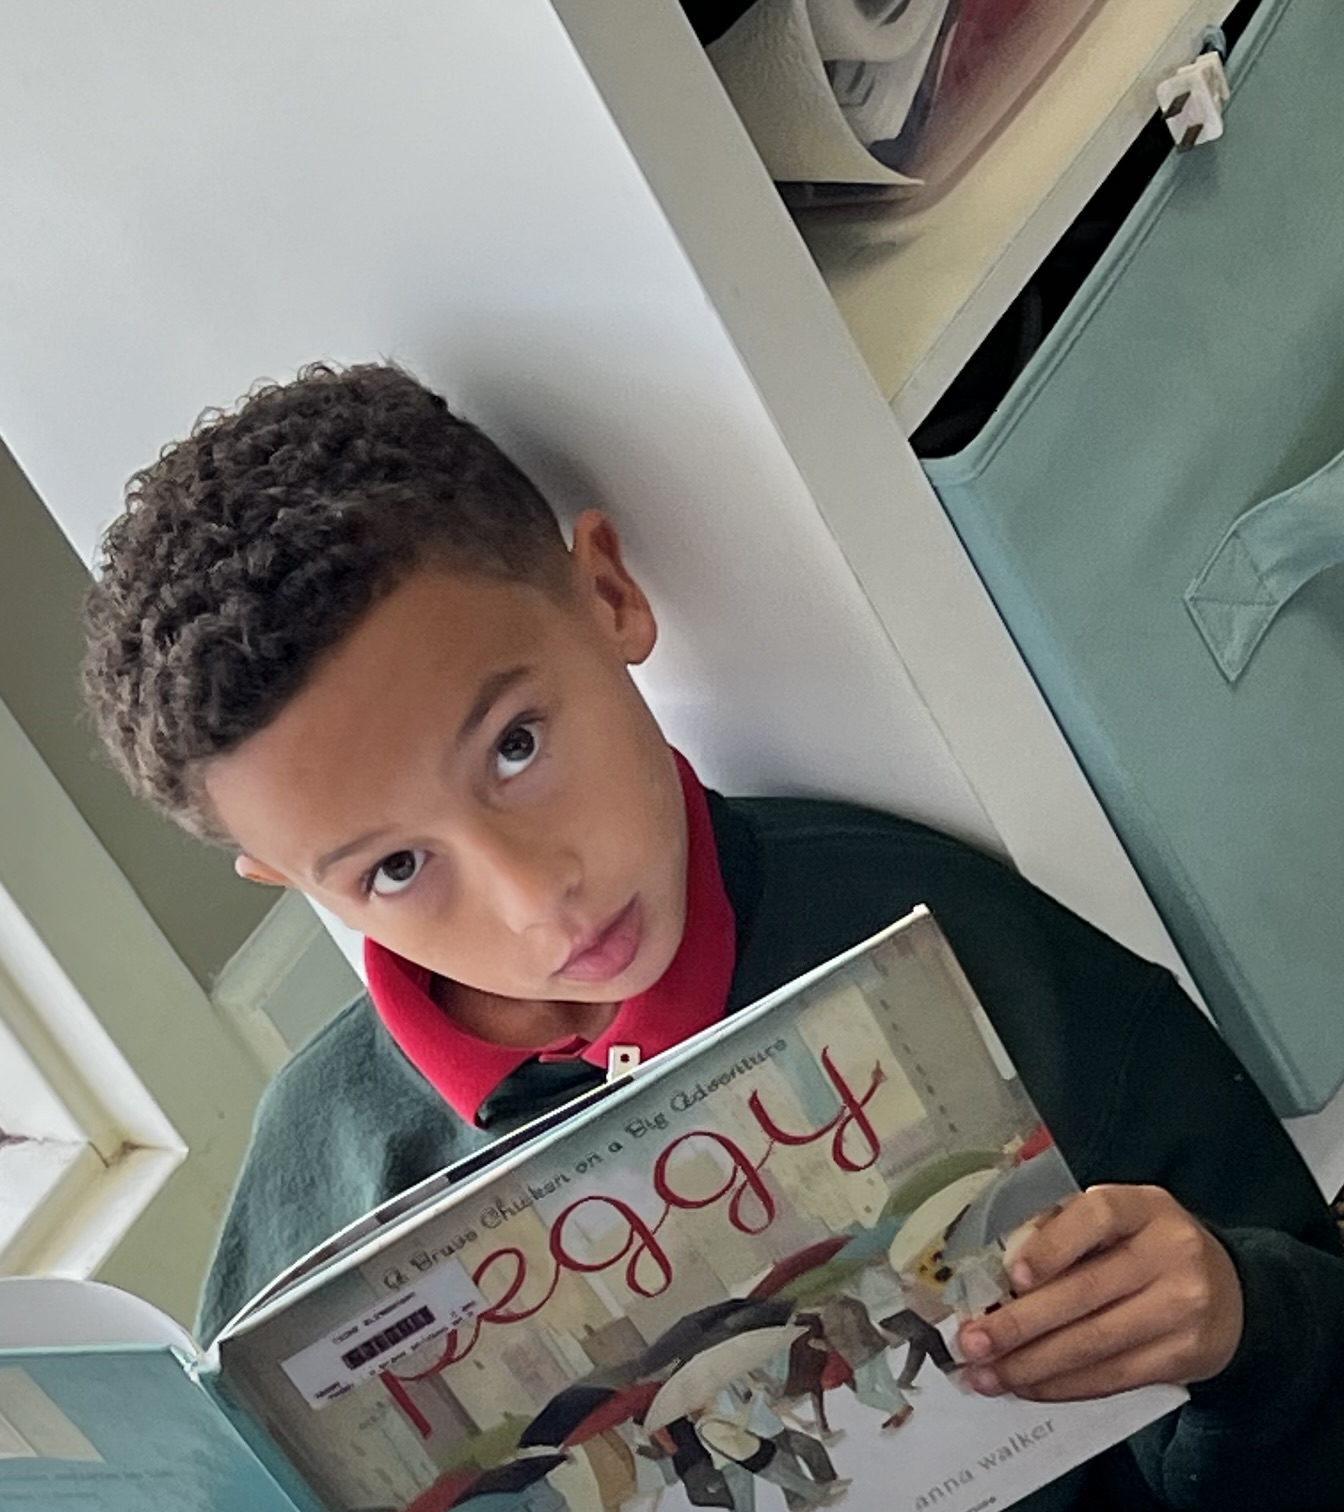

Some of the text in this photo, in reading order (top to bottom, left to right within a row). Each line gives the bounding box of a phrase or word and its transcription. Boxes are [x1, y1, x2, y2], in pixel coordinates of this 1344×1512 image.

[410, 1229, 478, 1272] Brave
[479, 1172, 571, 1231] Chicken
[575, 1150, 604, 1175] on
[608, 1140, 624, 1154] a
[624, 1106, 669, 1140] Big
[669, 1036, 789, 1113] Adventure
[914, 1418, 1056, 1512] anna walker
